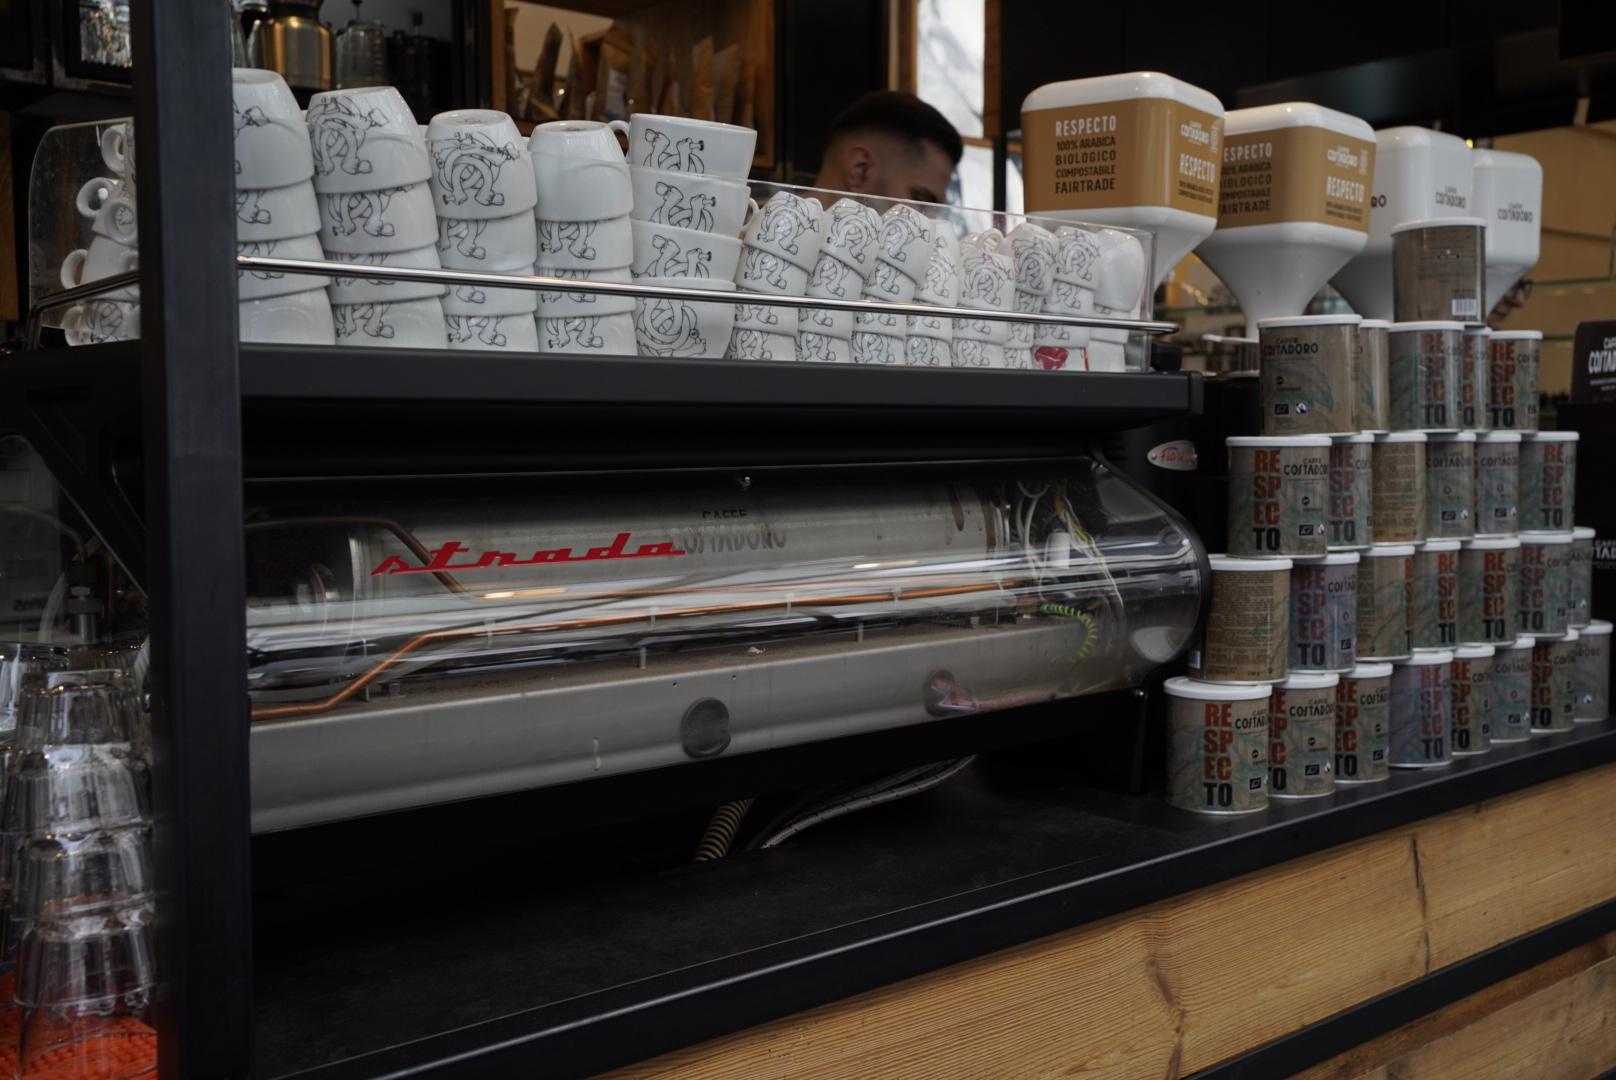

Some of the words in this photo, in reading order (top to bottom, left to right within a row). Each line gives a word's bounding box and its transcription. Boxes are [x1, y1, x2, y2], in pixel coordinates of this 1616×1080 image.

[1055, 115, 1117, 137] RESPECTO
[1056, 139, 1078, 151] 100%
[1080, 136, 1116, 149] ARABICA
[1223, 142, 1273, 162] ESPECTO
[1055, 150, 1117, 165] BIOLOGICO
[1180, 153, 1215, 183] RESPECTO
[1238, 161, 1271, 174] ARABICA
[1056, 165, 1116, 178] COMPOSTABILE
[1055, 178, 1116, 194] FAIRTRADE
[1326, 176, 1364, 203] RESPECTO
[1264, 343, 1318, 356] COSTADORO
[1491, 342, 1515, 361] RE
[1491, 364, 1515, 383] SP
[1491, 386, 1514, 405] EC
[1421, 404, 1446, 425] TO
[1491, 408, 1514, 427] TO
[1254, 449, 1281, 473] RE
[1543, 444, 1564, 463] RE
[1543, 465, 1564, 484] SP
[1253, 475, 1281, 499] SP
[1542, 487, 1563, 505] EC
[1253, 501, 1280, 525] EC
[1541, 508, 1562, 527] TO
[1252, 527, 1281, 551] TO
[370, 532, 686, 576] strada
[1438, 553, 1454, 574] RE
[1484, 552, 1505, 572] RE
[1522, 545, 1545, 565] RE
[1299, 568, 1325, 590] RE
[1438, 576, 1455, 597] SP
[1483, 574, 1505, 594] SP
[1520, 567, 1545, 586] SP
[1298, 592, 1326, 615] SP
[1483, 596, 1504, 617] EC
[1520, 588, 1544, 608] EC
[1438, 600, 1455, 620] EC
[1519, 610, 1544, 630] TO
[1298, 618, 1325, 640] EC
[1438, 623, 1455, 643] TO
[1483, 619, 1505, 638] TO
[1297, 643, 1325, 666] TO
[1421, 667, 1441, 688] RE
[1421, 690, 1443, 713] SP
[1204, 703, 1232, 727] RE
[1421, 714, 1442, 736] EC
[1203, 729, 1233, 754] SP
[1421, 737, 1443, 759] TO
[1270, 741, 1286, 765] C
[1204, 756, 1232, 780] EC
[1203, 782, 1233, 807] TO
